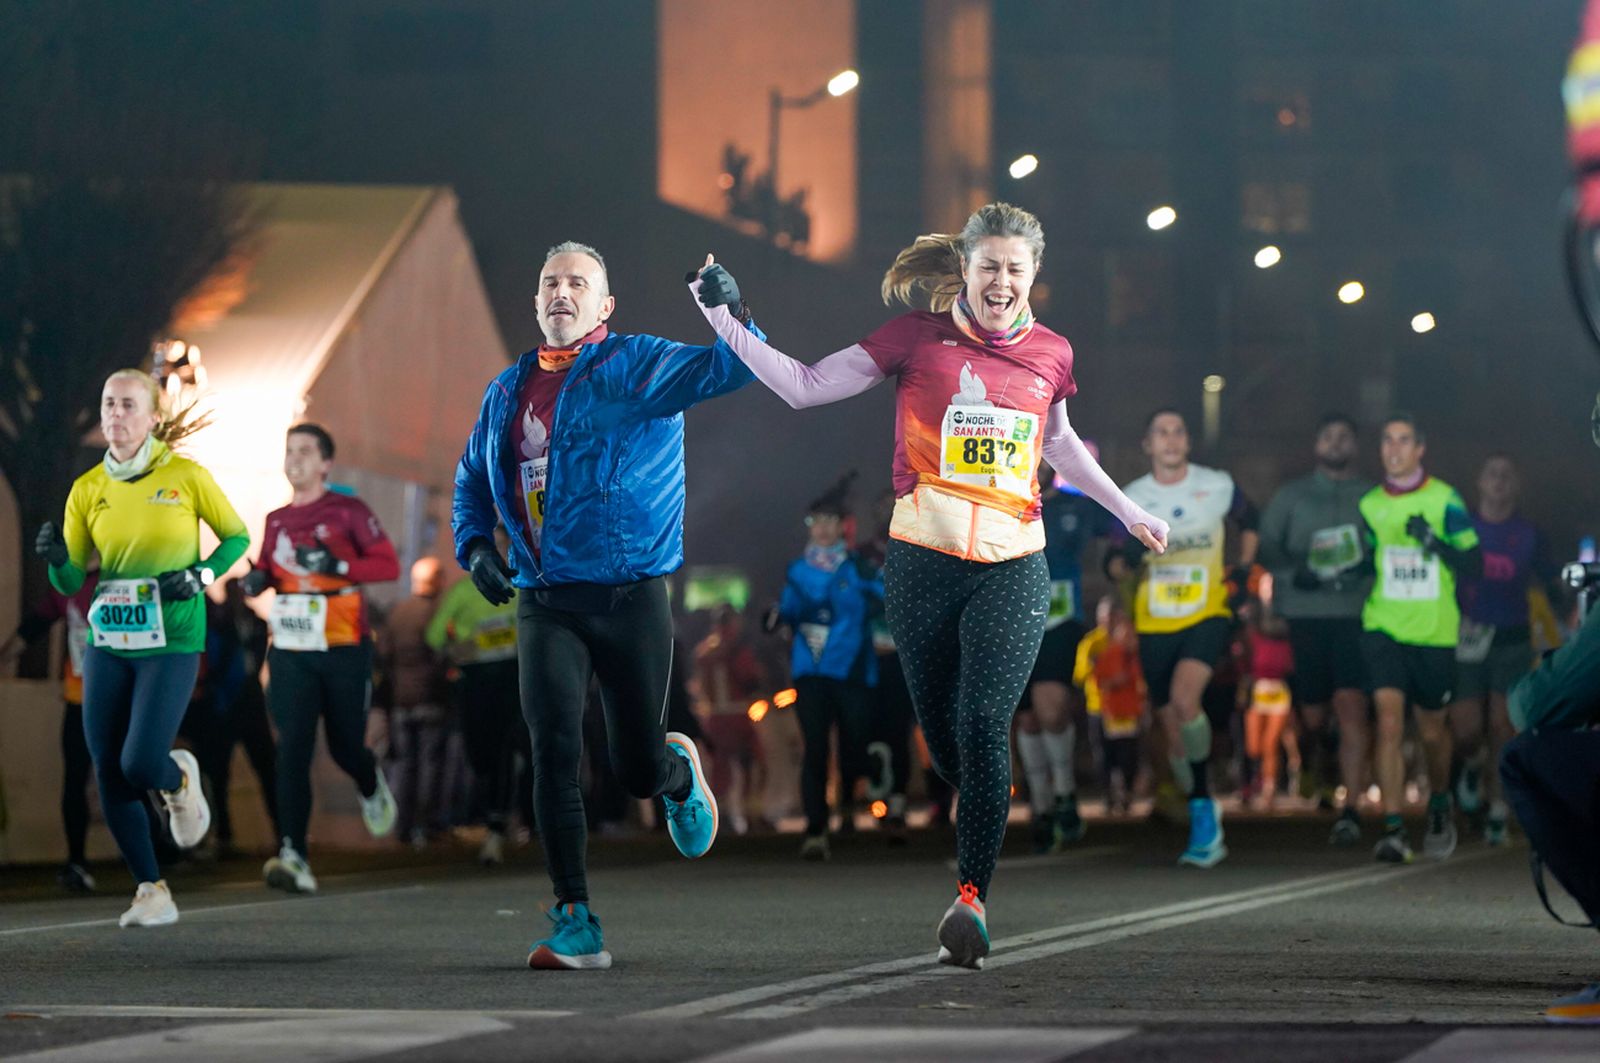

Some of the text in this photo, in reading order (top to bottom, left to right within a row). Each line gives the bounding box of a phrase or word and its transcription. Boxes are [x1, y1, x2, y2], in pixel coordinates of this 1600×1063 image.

[965, 416, 995, 425] NOCHE
[953, 427, 973, 436] SAN
[530, 480, 544, 491] SAN
[100, 604, 147, 625] 3020
